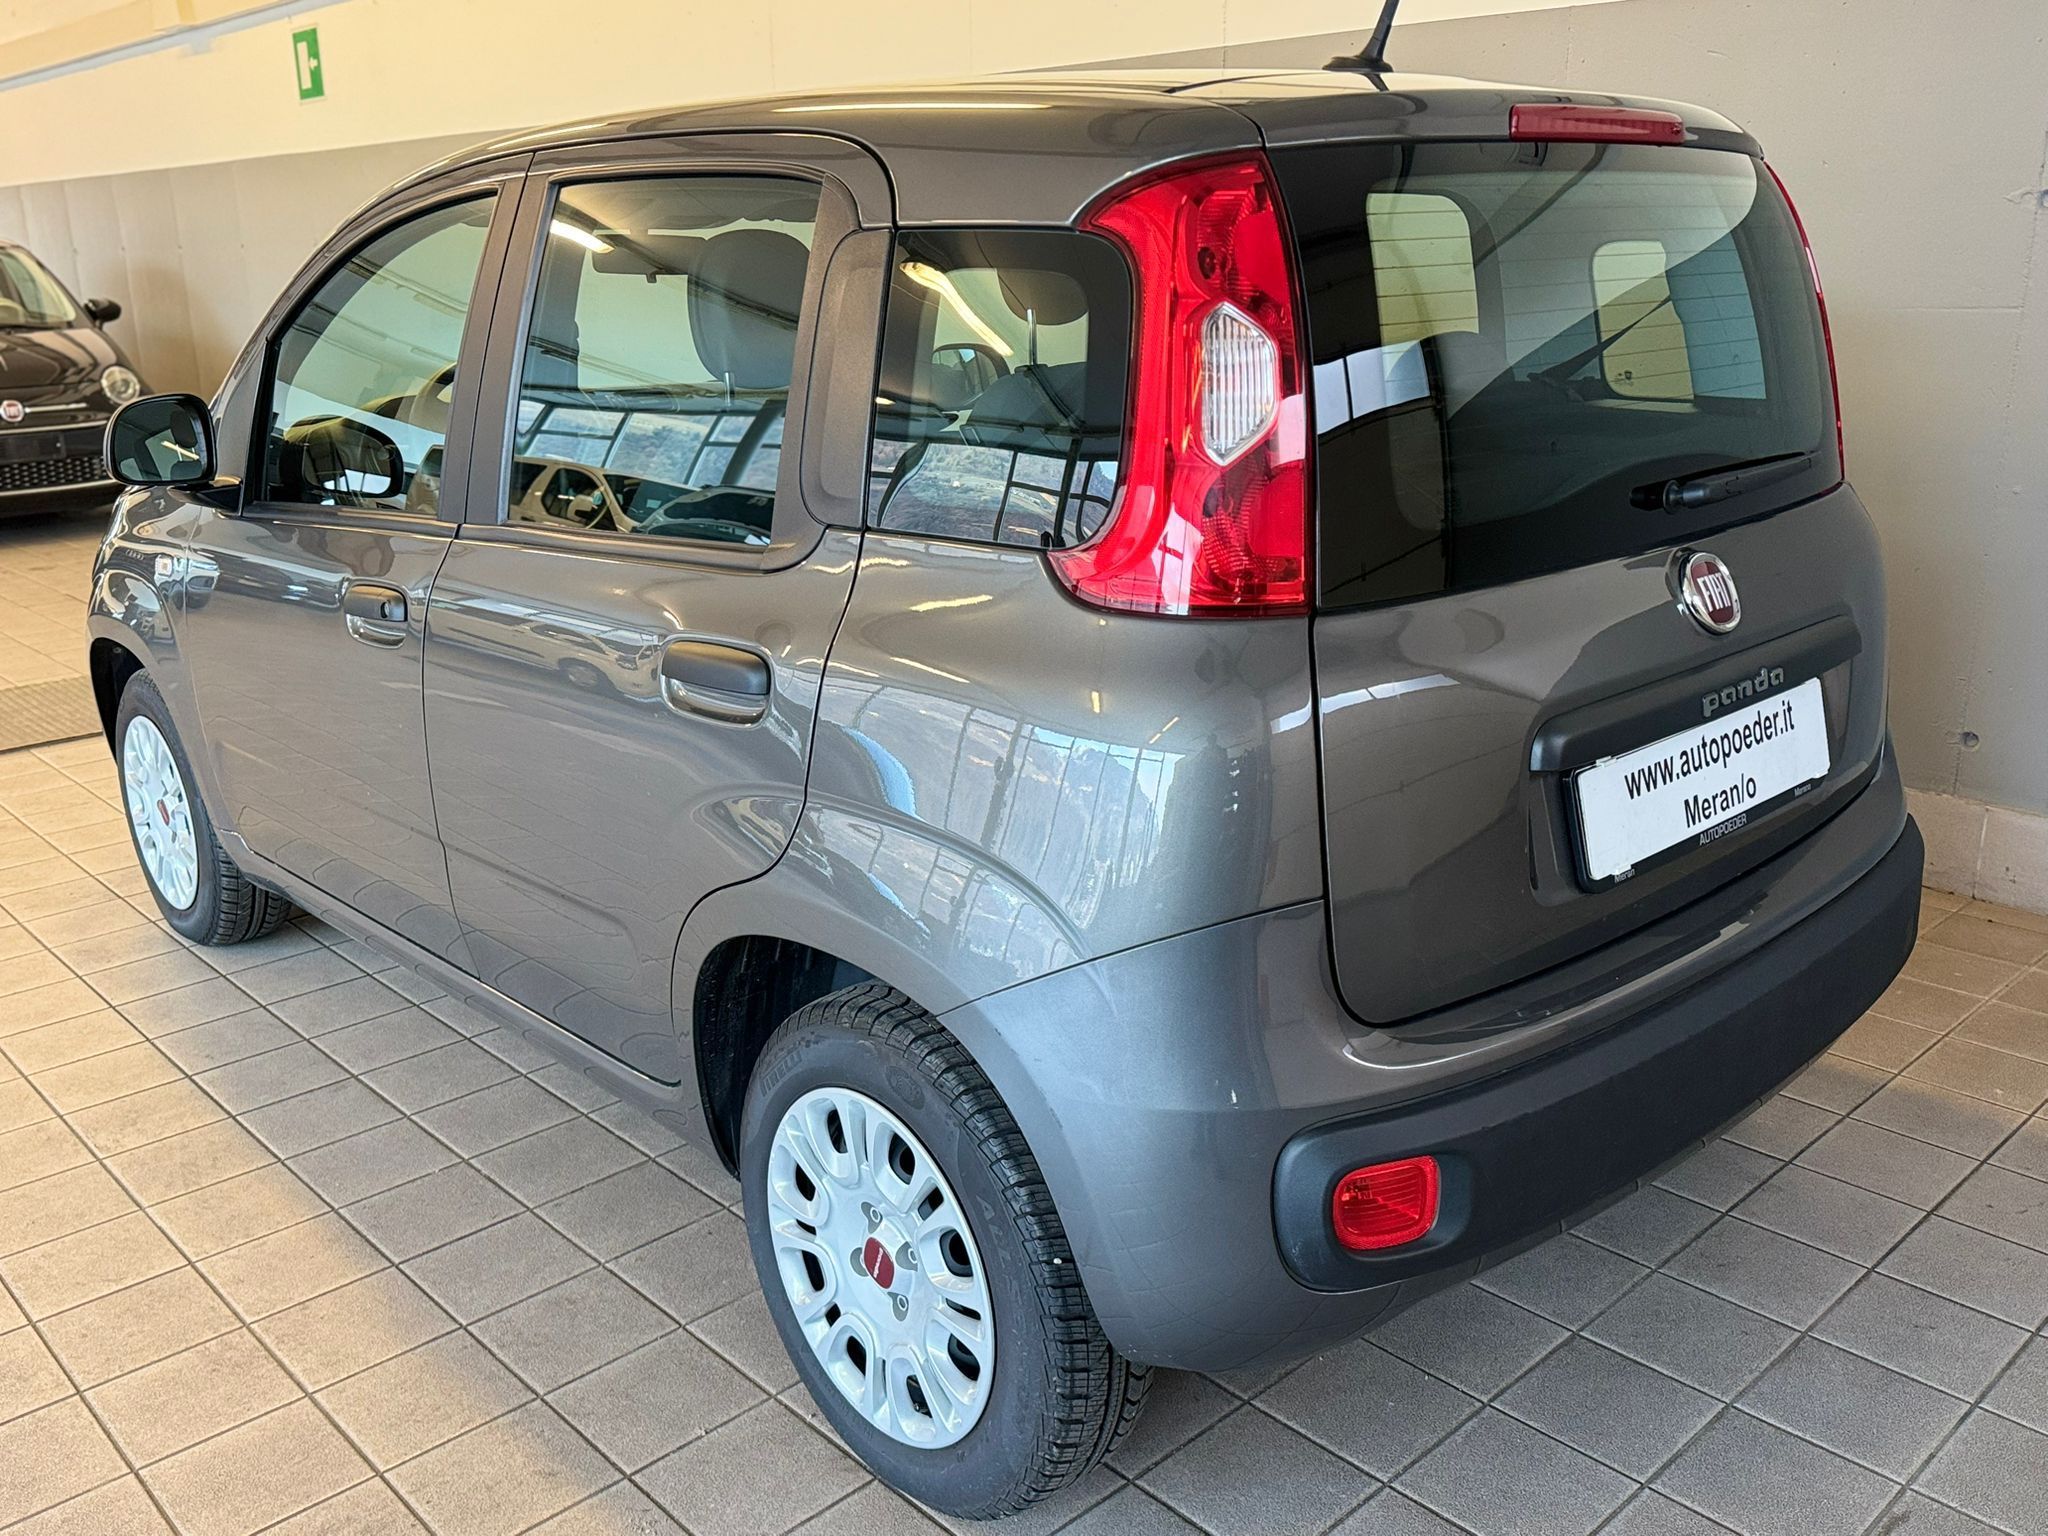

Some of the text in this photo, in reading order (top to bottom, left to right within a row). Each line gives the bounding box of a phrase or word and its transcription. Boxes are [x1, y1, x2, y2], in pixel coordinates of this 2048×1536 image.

[1696, 572, 1732, 613] FIAT
[1702, 667, 1784, 718] panda
[1624, 700, 1795, 800] www.autopoeder.it
[1684, 773, 1757, 829] Meran/o
[1699, 813, 1748, 846] AUTOPOEDER
